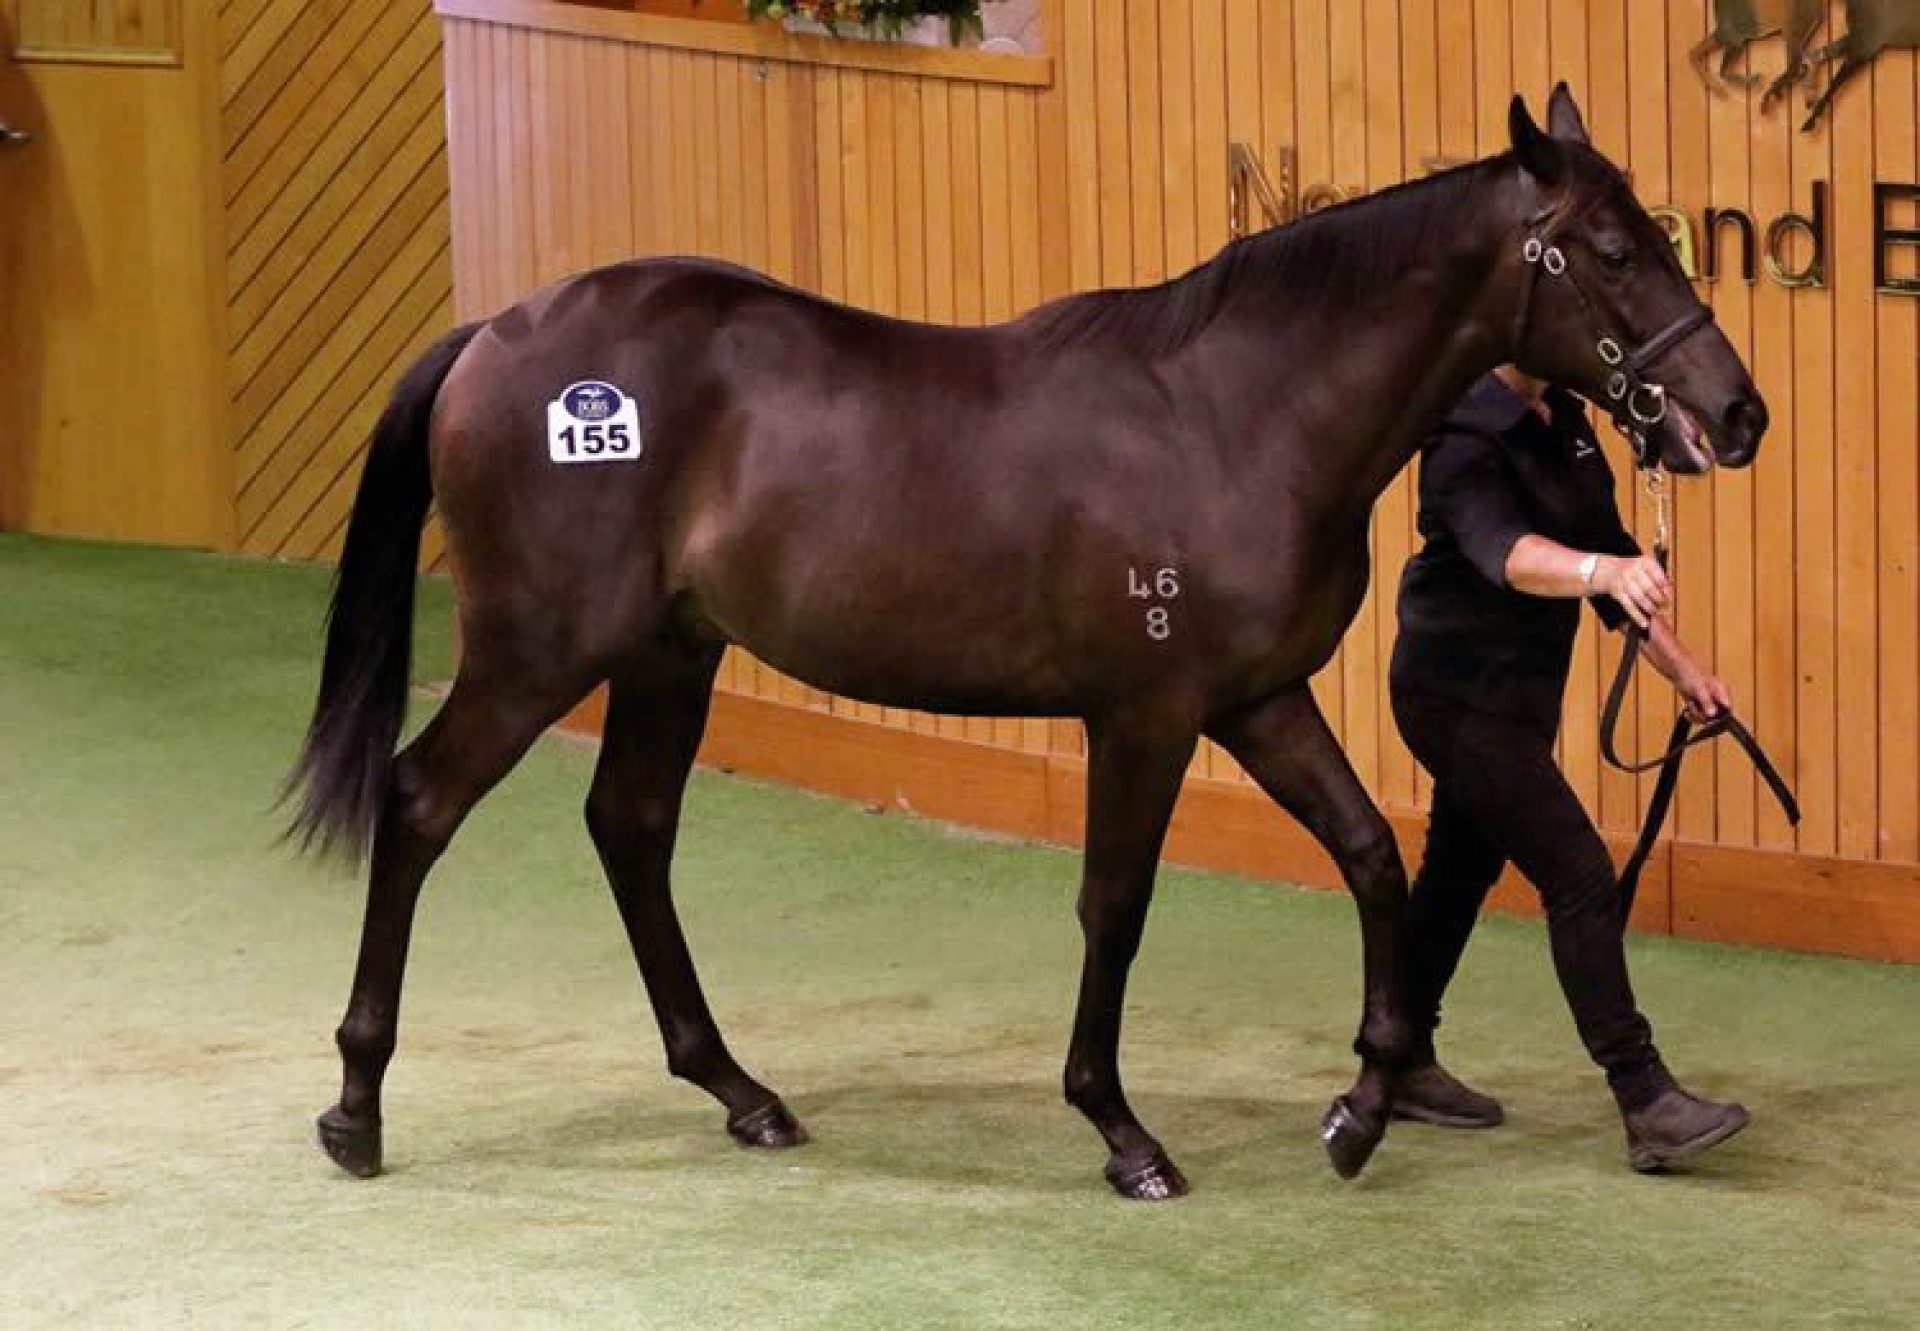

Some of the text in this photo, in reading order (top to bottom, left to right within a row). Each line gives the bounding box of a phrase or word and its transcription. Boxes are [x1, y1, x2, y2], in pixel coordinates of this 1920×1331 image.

[558, 423, 631, 456] 155
[1127, 567, 1179, 600] 46
[1146, 606, 1171, 641] 8
